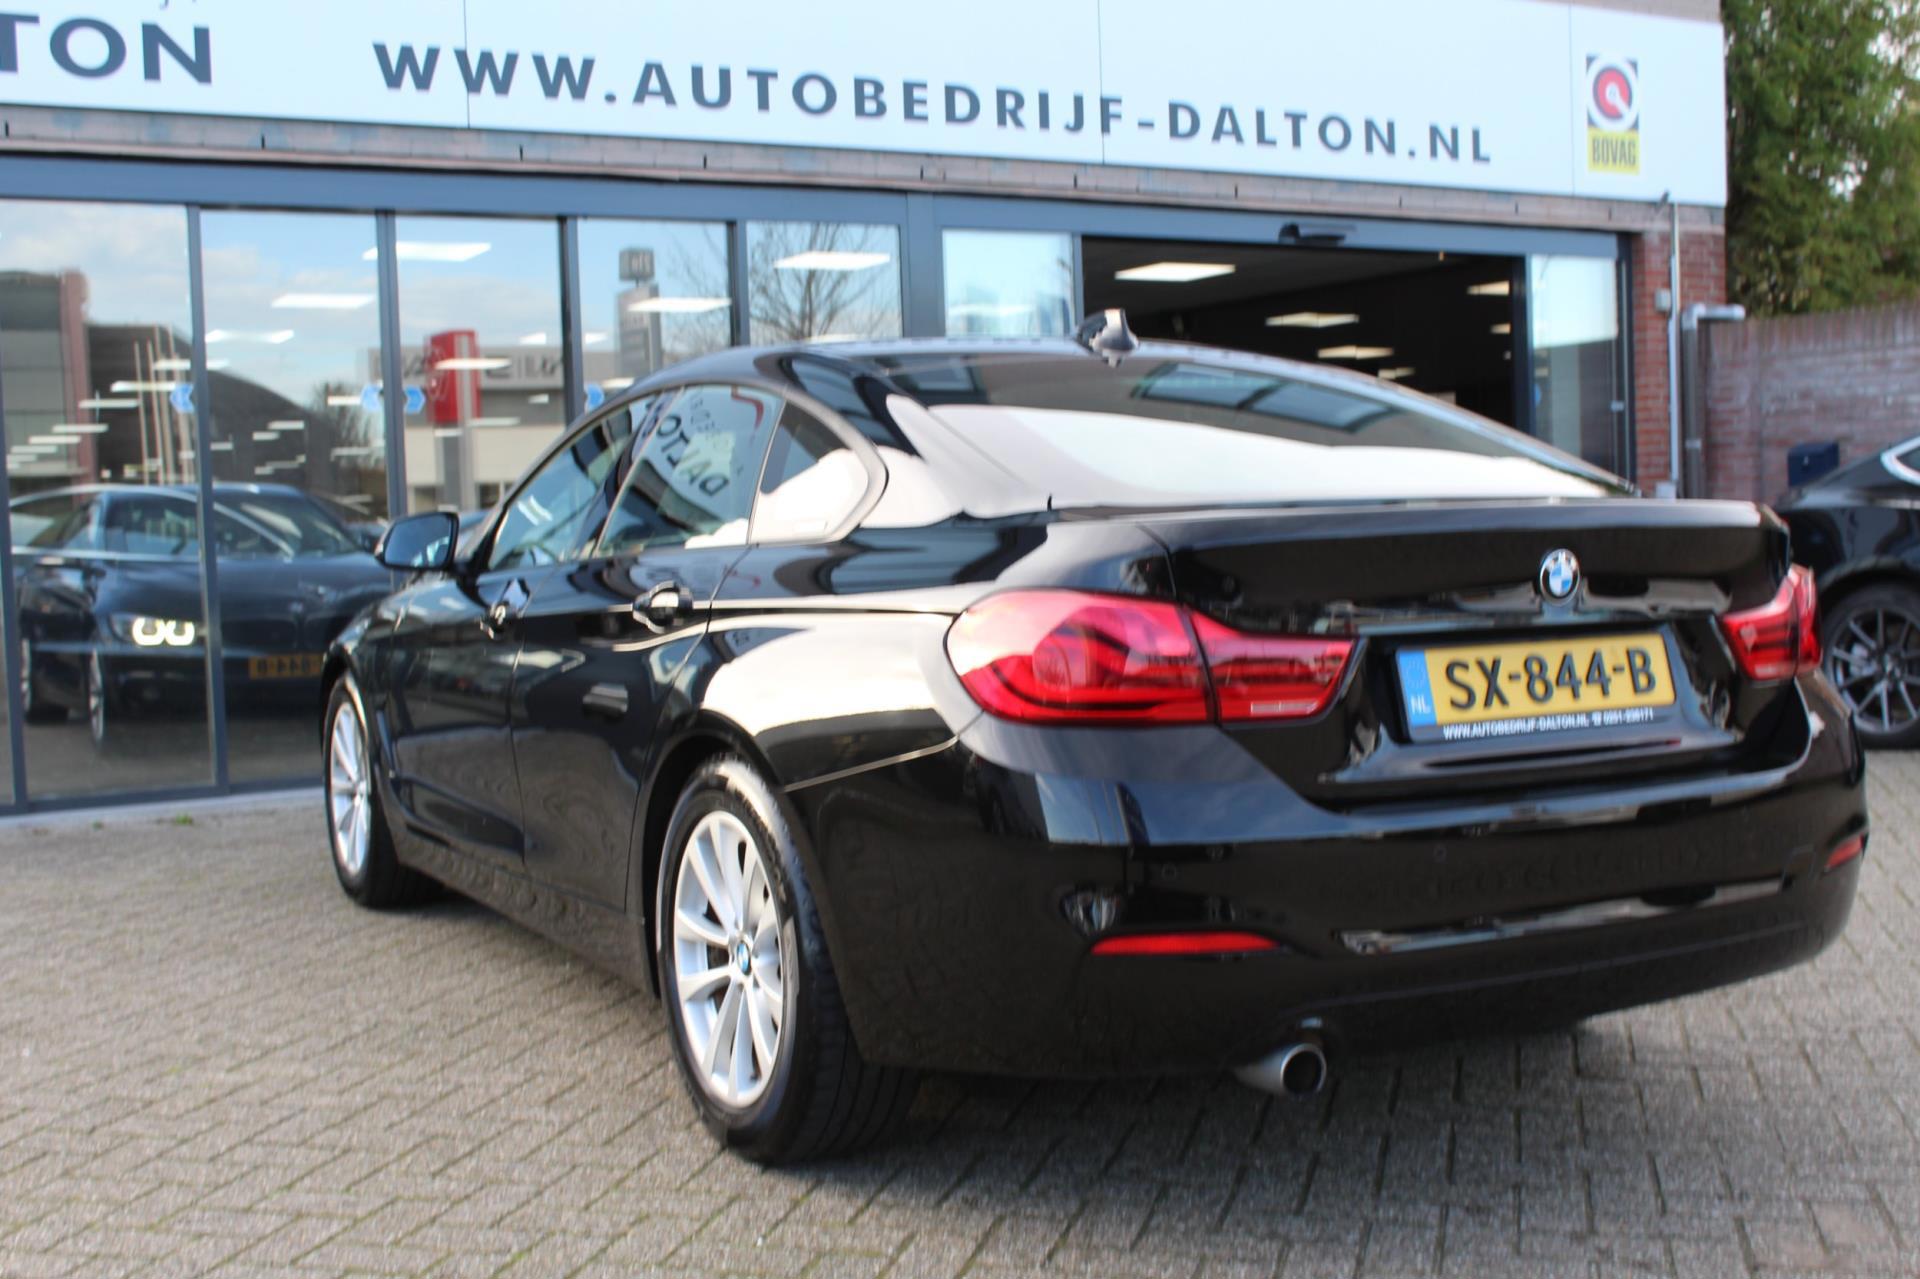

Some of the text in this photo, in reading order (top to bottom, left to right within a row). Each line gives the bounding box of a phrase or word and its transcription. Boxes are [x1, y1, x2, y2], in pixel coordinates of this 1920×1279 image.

[0, 13, 212, 84] TON
[372, 42, 1491, 163] WWW.AUTOBEDRIJF-DALTON.NL
[1592, 136, 1637, 167] BOVAG
[1411, 647, 1657, 715] NL SX-844-B
[1443, 712, 1589, 740] WWW.AUTOBEDRIJF-DALTON.NL
